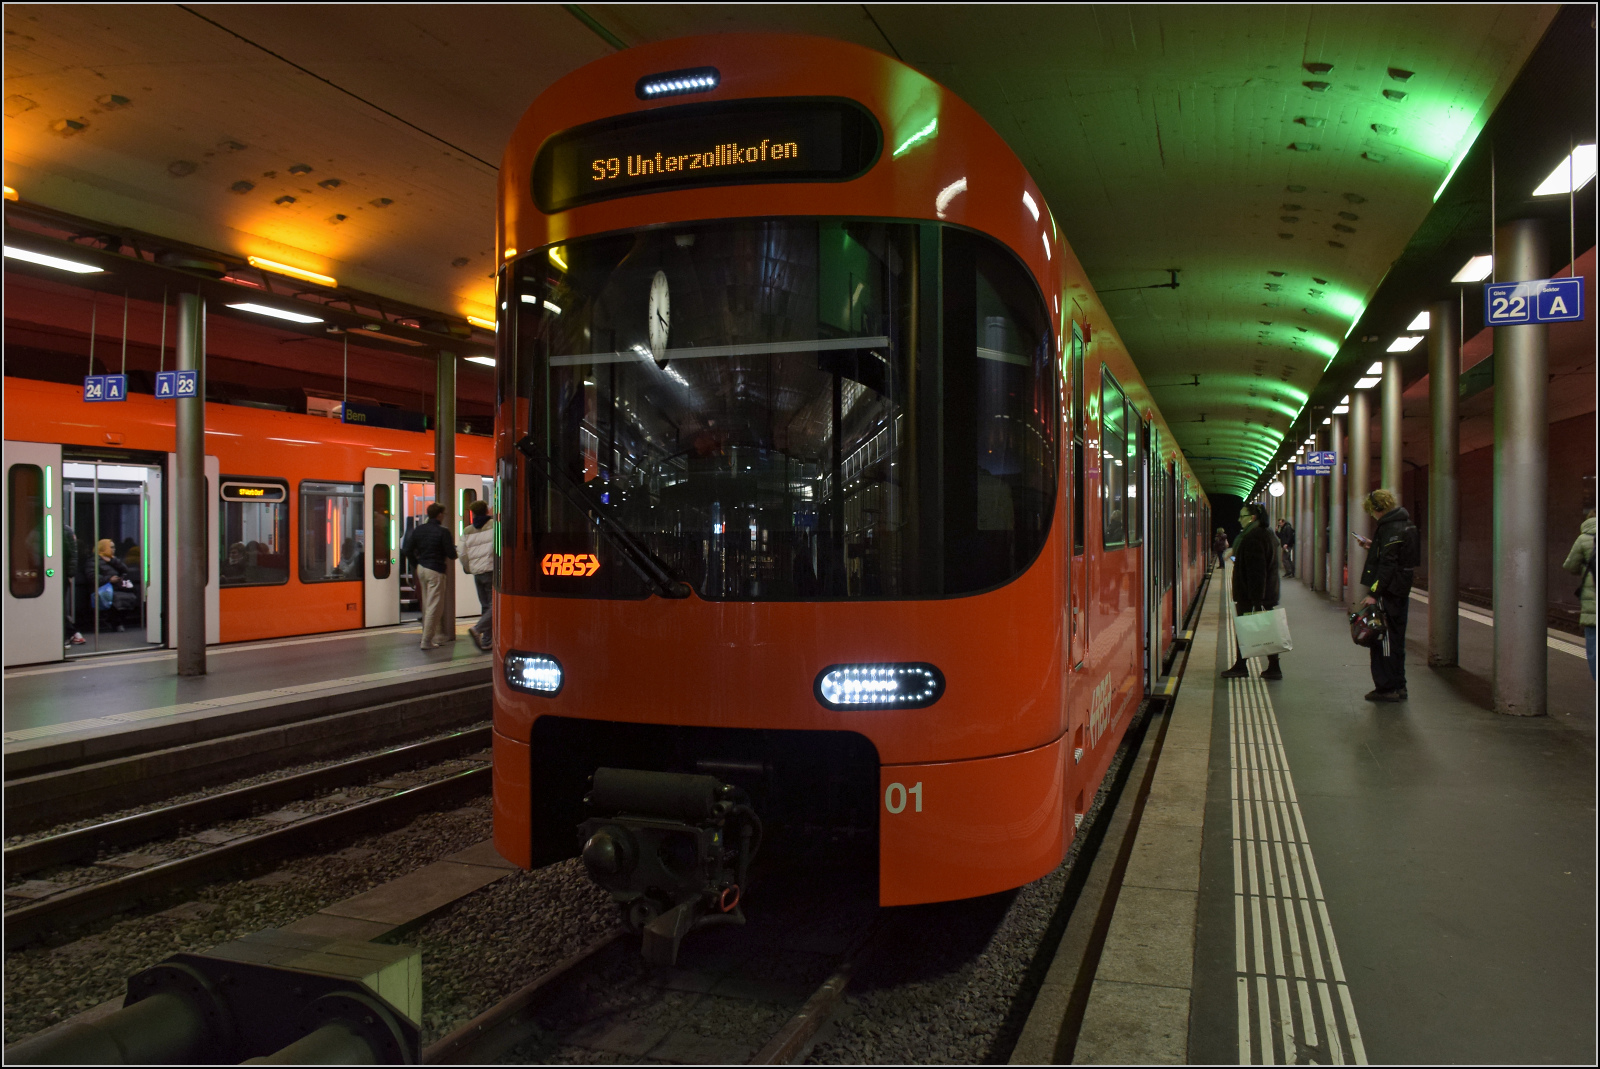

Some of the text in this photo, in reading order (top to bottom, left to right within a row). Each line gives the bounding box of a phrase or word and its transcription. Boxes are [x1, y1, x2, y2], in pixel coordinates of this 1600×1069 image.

[592, 139, 798, 181] S9 Unterzollikofen
[1492, 296, 1526, 319] 22
[1549, 296, 1568, 315] A
[86, 384, 102, 398] 24
[110, 385, 119, 397] A
[161, 382, 170, 394] A
[178, 379, 194, 393] 23
[346, 409, 366, 422] Bern
[548, 554, 590, 576] RBS
[885, 781, 923, 814] 01
